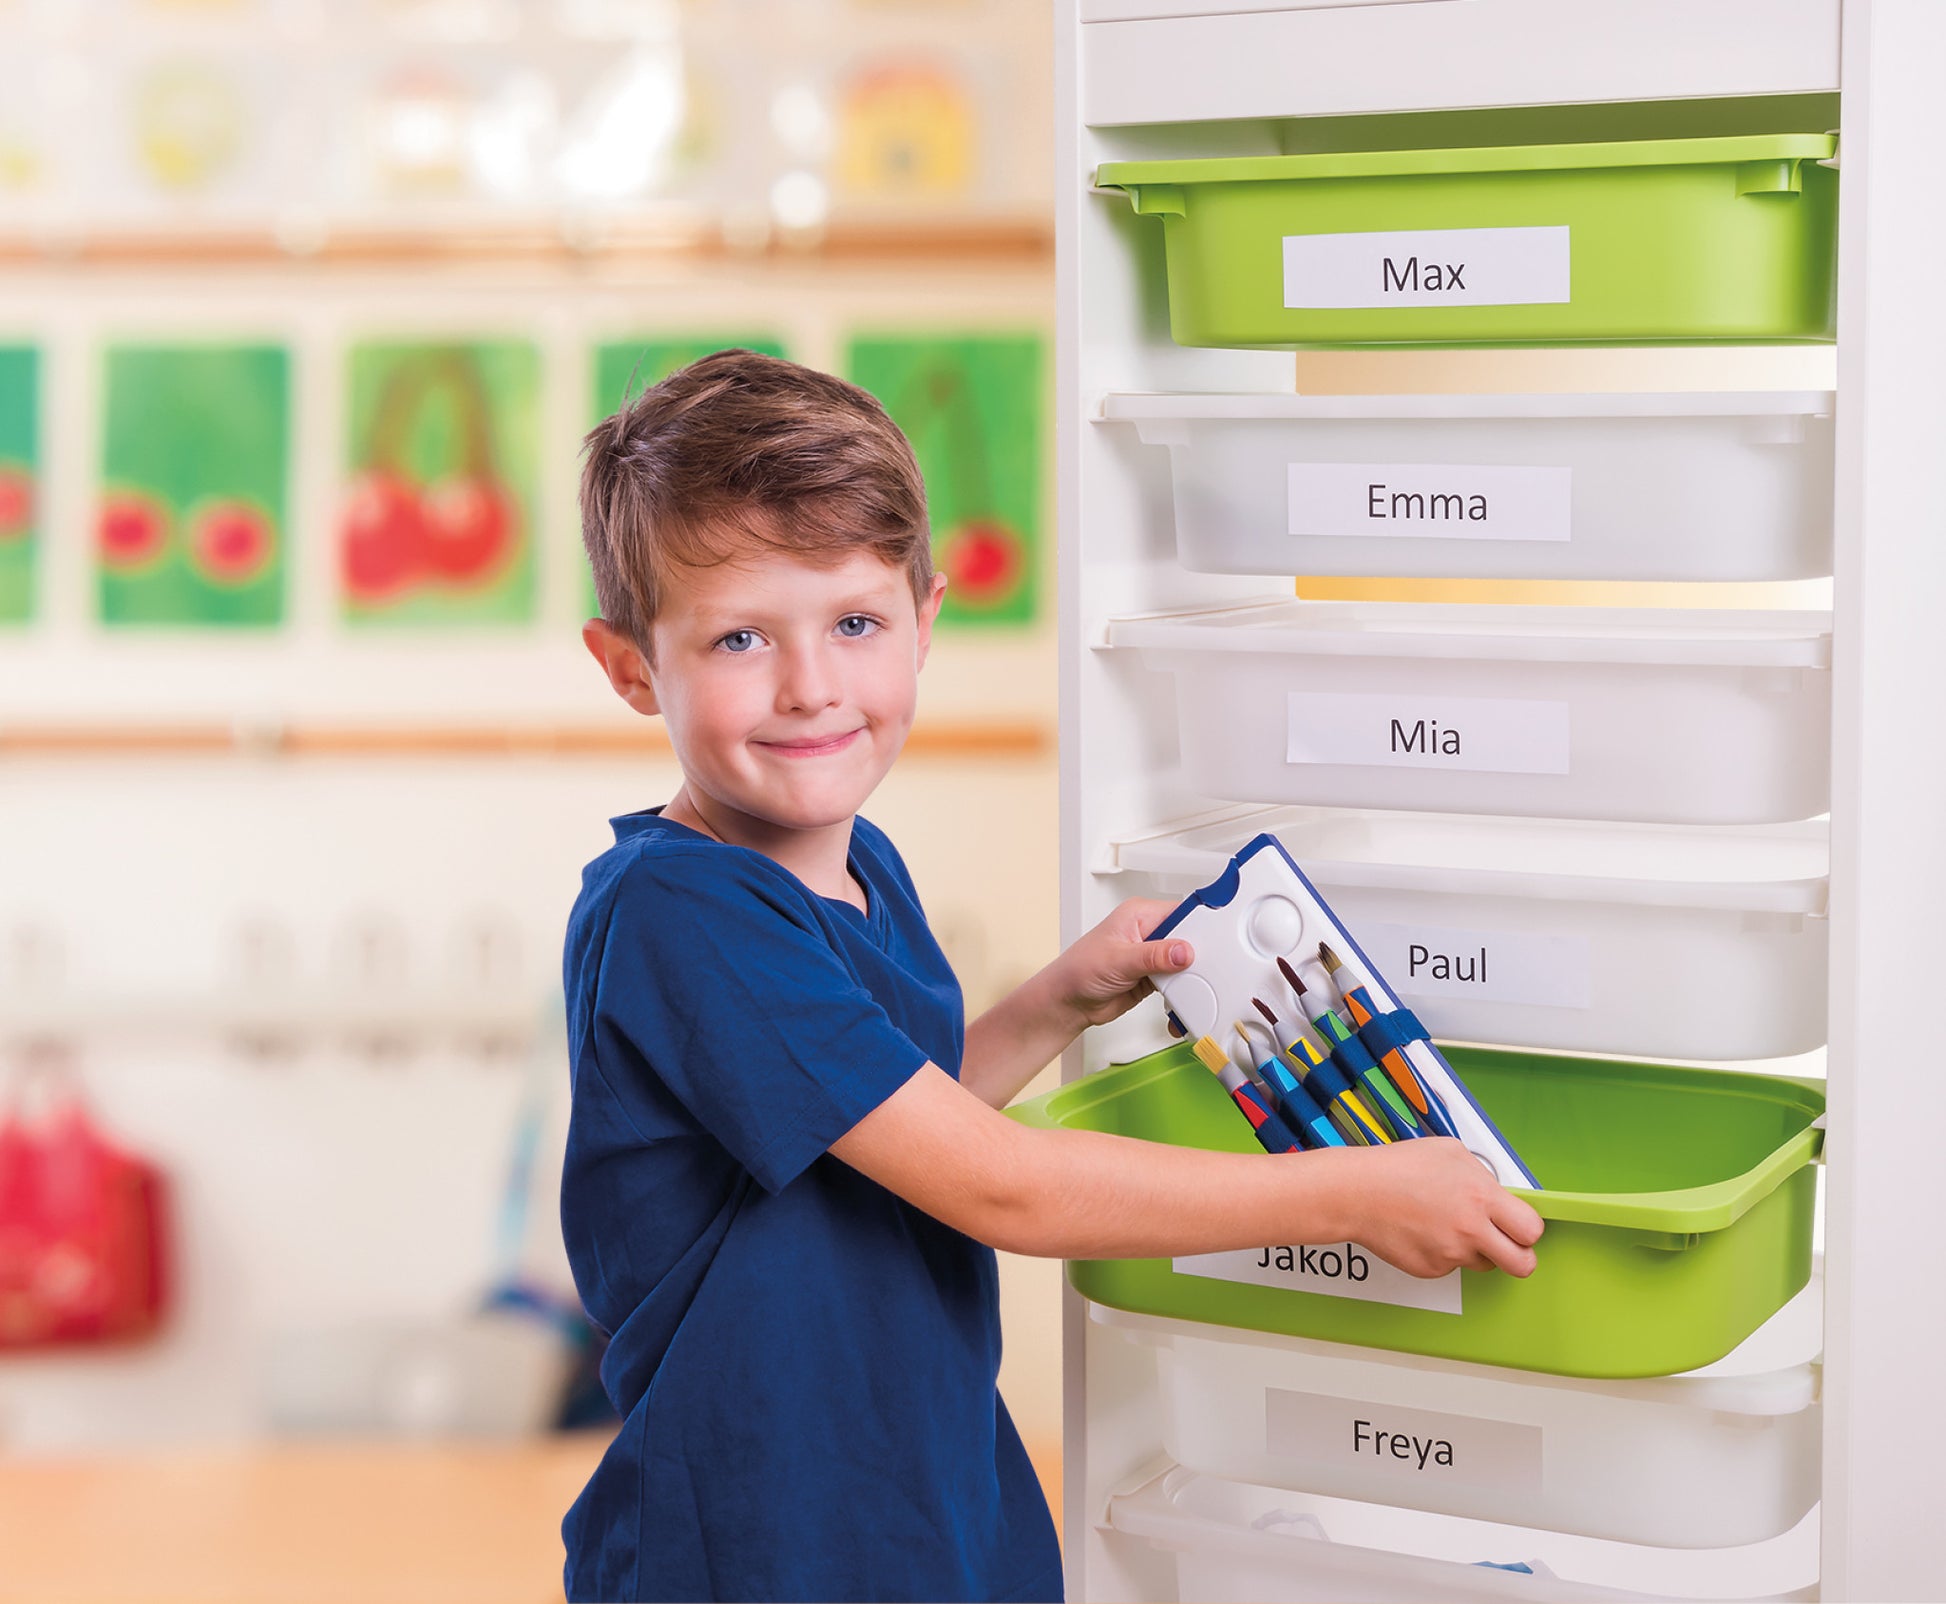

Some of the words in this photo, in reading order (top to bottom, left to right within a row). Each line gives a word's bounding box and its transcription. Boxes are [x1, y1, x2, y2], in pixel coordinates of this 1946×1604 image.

[1383, 256, 1467, 292] Max
[1368, 484, 1488, 521] Emma
[1391, 719, 1461, 755] Mia
[1409, 944, 1487, 983] Paul
[1257, 1243, 1369, 1282] Jakob
[1353, 1419, 1454, 1470] Freya
